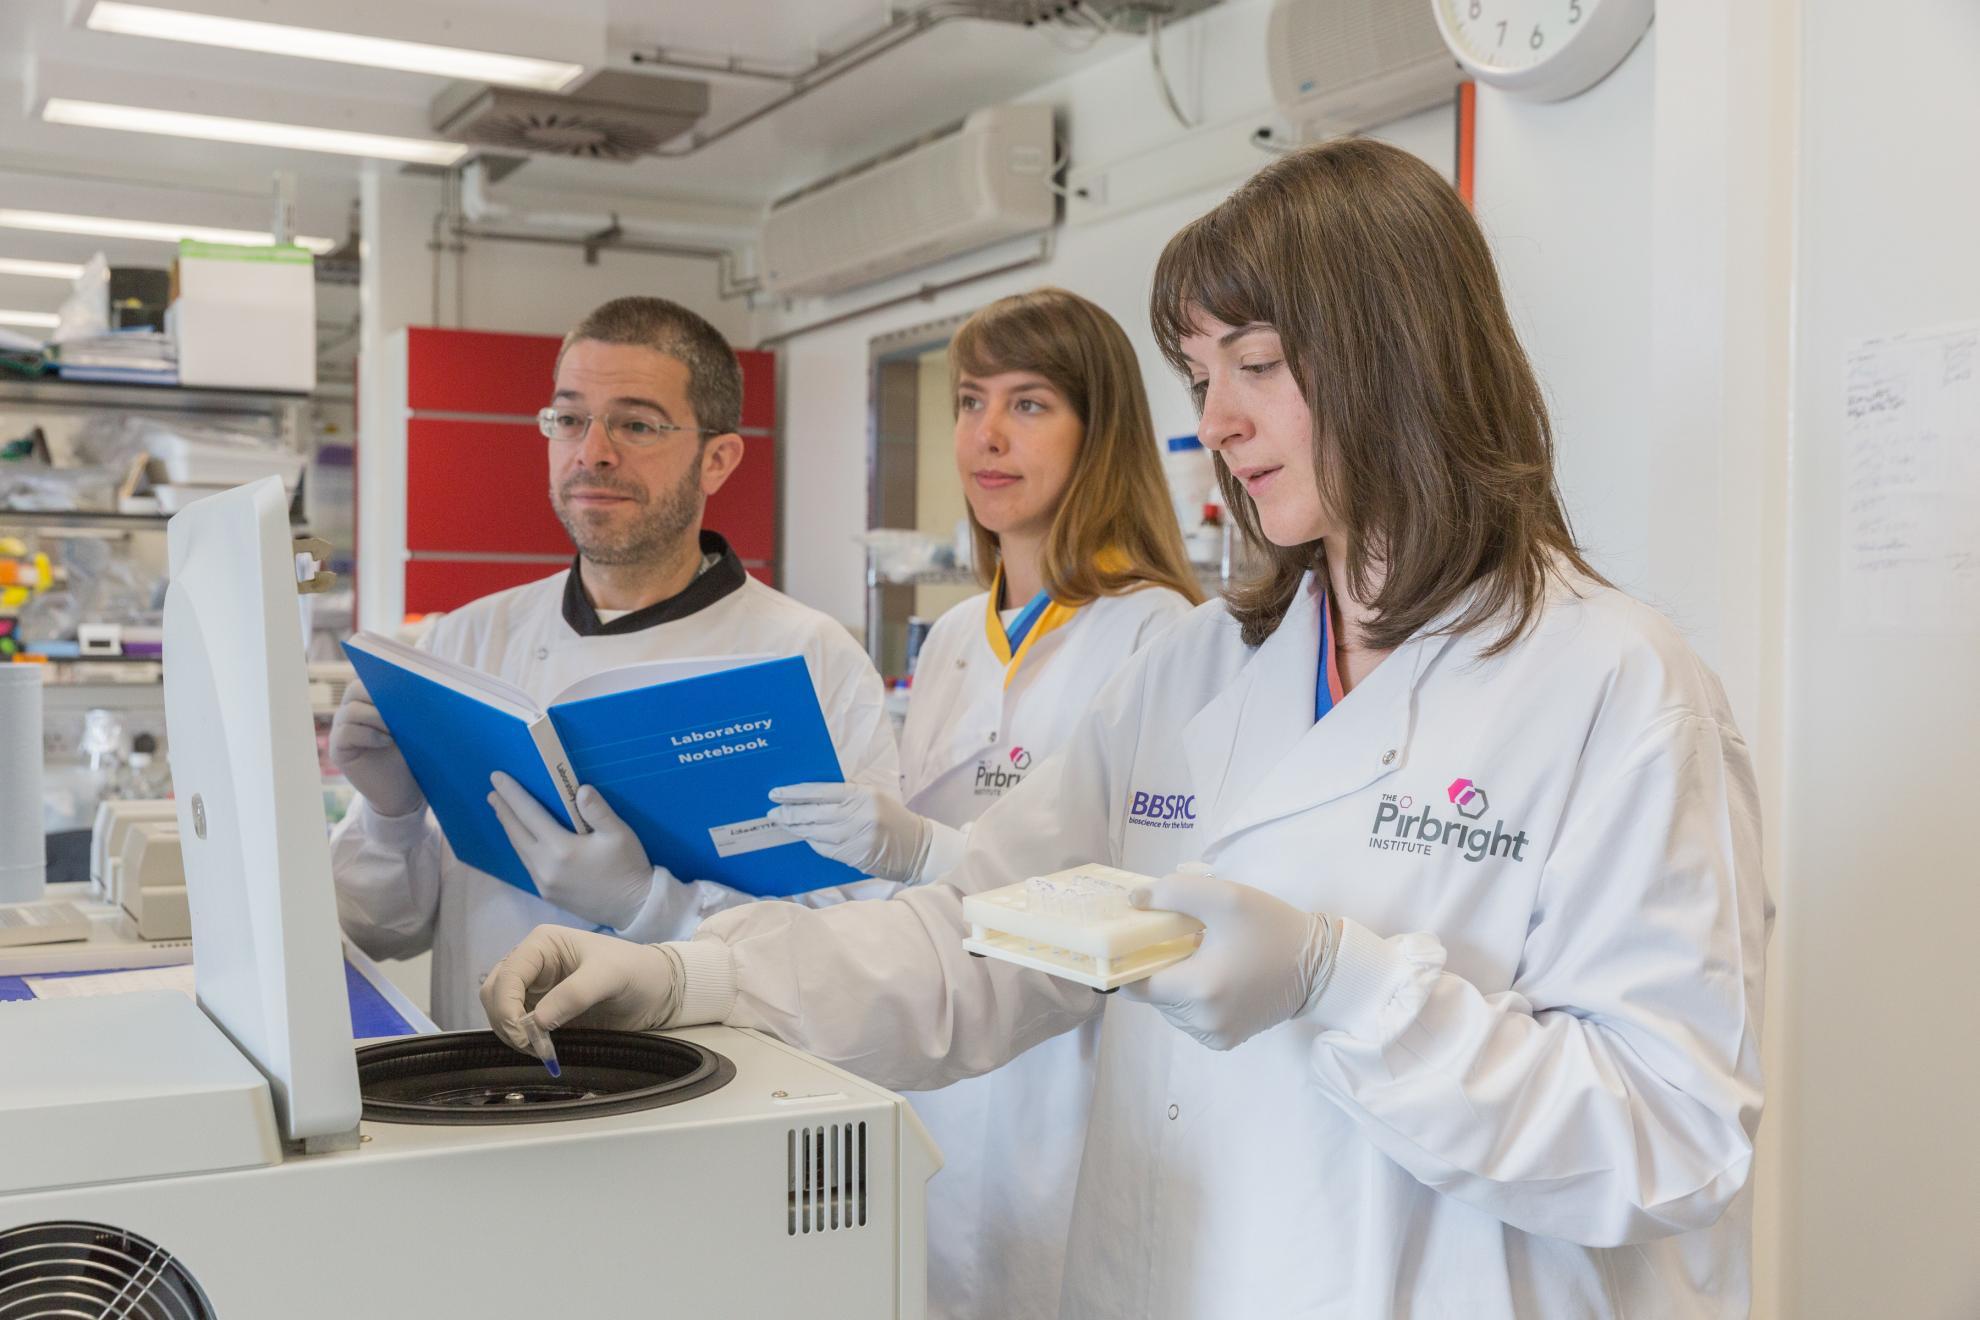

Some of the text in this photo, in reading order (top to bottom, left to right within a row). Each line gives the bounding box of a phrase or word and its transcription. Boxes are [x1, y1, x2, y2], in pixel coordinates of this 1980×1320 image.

[1469, 0, 1481, 20] 8
[1568, 0, 1581, 24] 5
[1496, 21, 1508, 48] 7
[1529, 23, 1544, 50] 6
[670, 718, 772, 746] Laboratory
[678, 737, 768, 764] Notebook
[975, 764, 1025, 788] Pirbri
[1131, 791, 1196, 820] BBSRC
[1382, 793, 1397, 802] THE
[1128, 816, 1161, 828] bioscience
[1162, 820, 1171, 829] for
[1372, 801, 1529, 863] Pirbright
[1368, 837, 1433, 856] INSTITUTE
